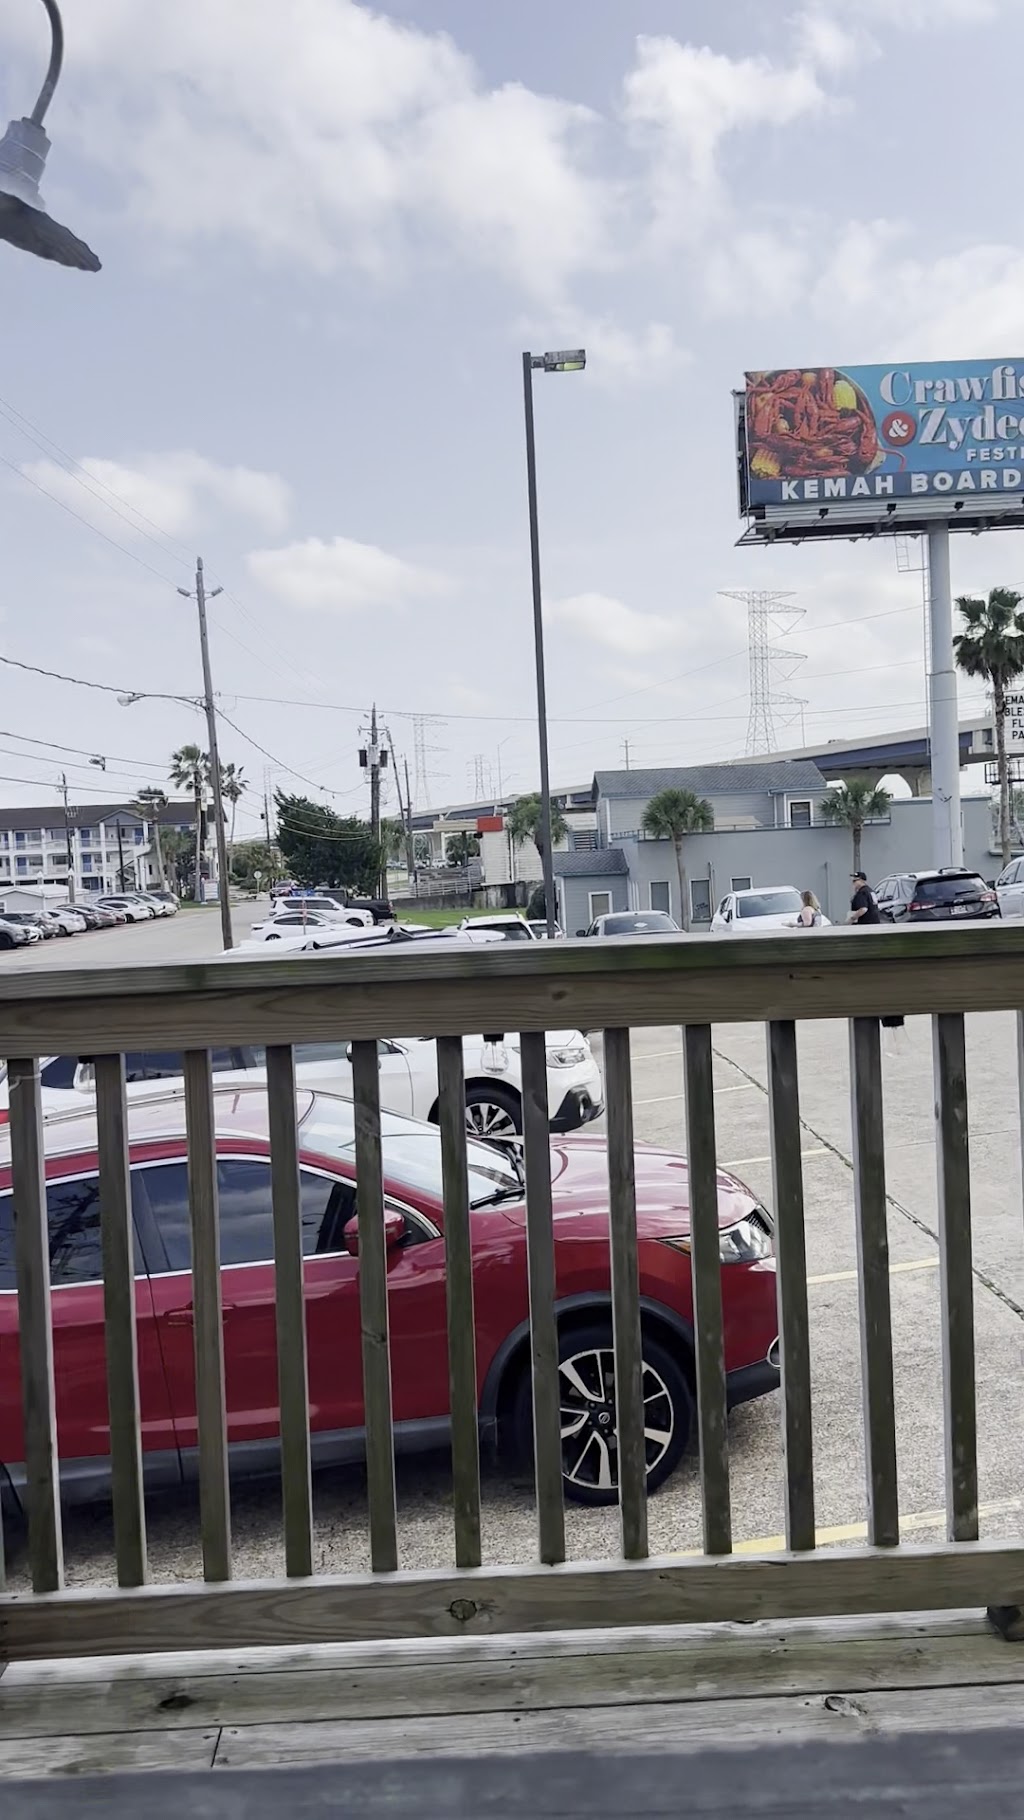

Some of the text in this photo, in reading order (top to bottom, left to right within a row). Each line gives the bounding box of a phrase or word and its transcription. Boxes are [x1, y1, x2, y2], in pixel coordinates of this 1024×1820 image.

[888, 418, 909, 438] &
[781, 468, 1022, 500] KEMAH BOARD
[1005, 695, 1024, 705] EMA
